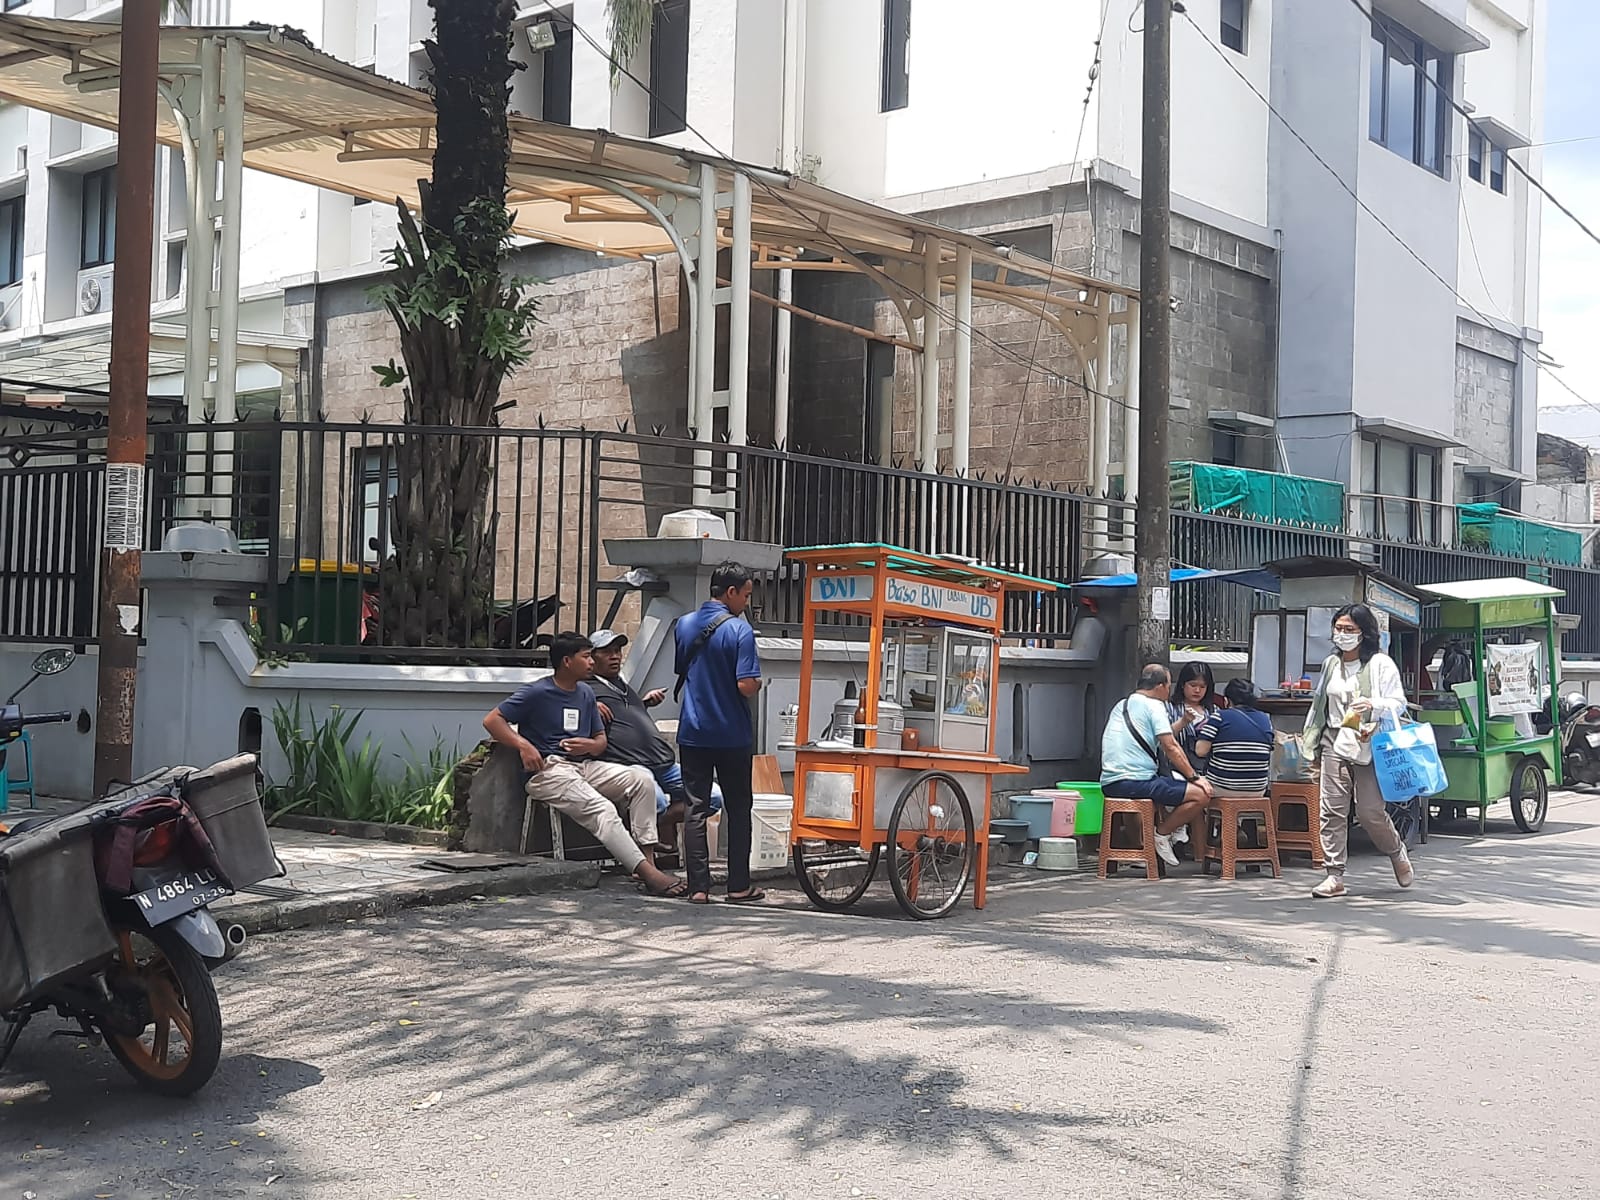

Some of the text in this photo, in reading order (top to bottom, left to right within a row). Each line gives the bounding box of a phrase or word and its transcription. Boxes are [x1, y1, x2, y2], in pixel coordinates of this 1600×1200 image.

[819, 577, 856, 600] BNI
[971, 595, 992, 618] UB
[138, 894, 153, 909] N
[157, 877, 194, 902] 4864
